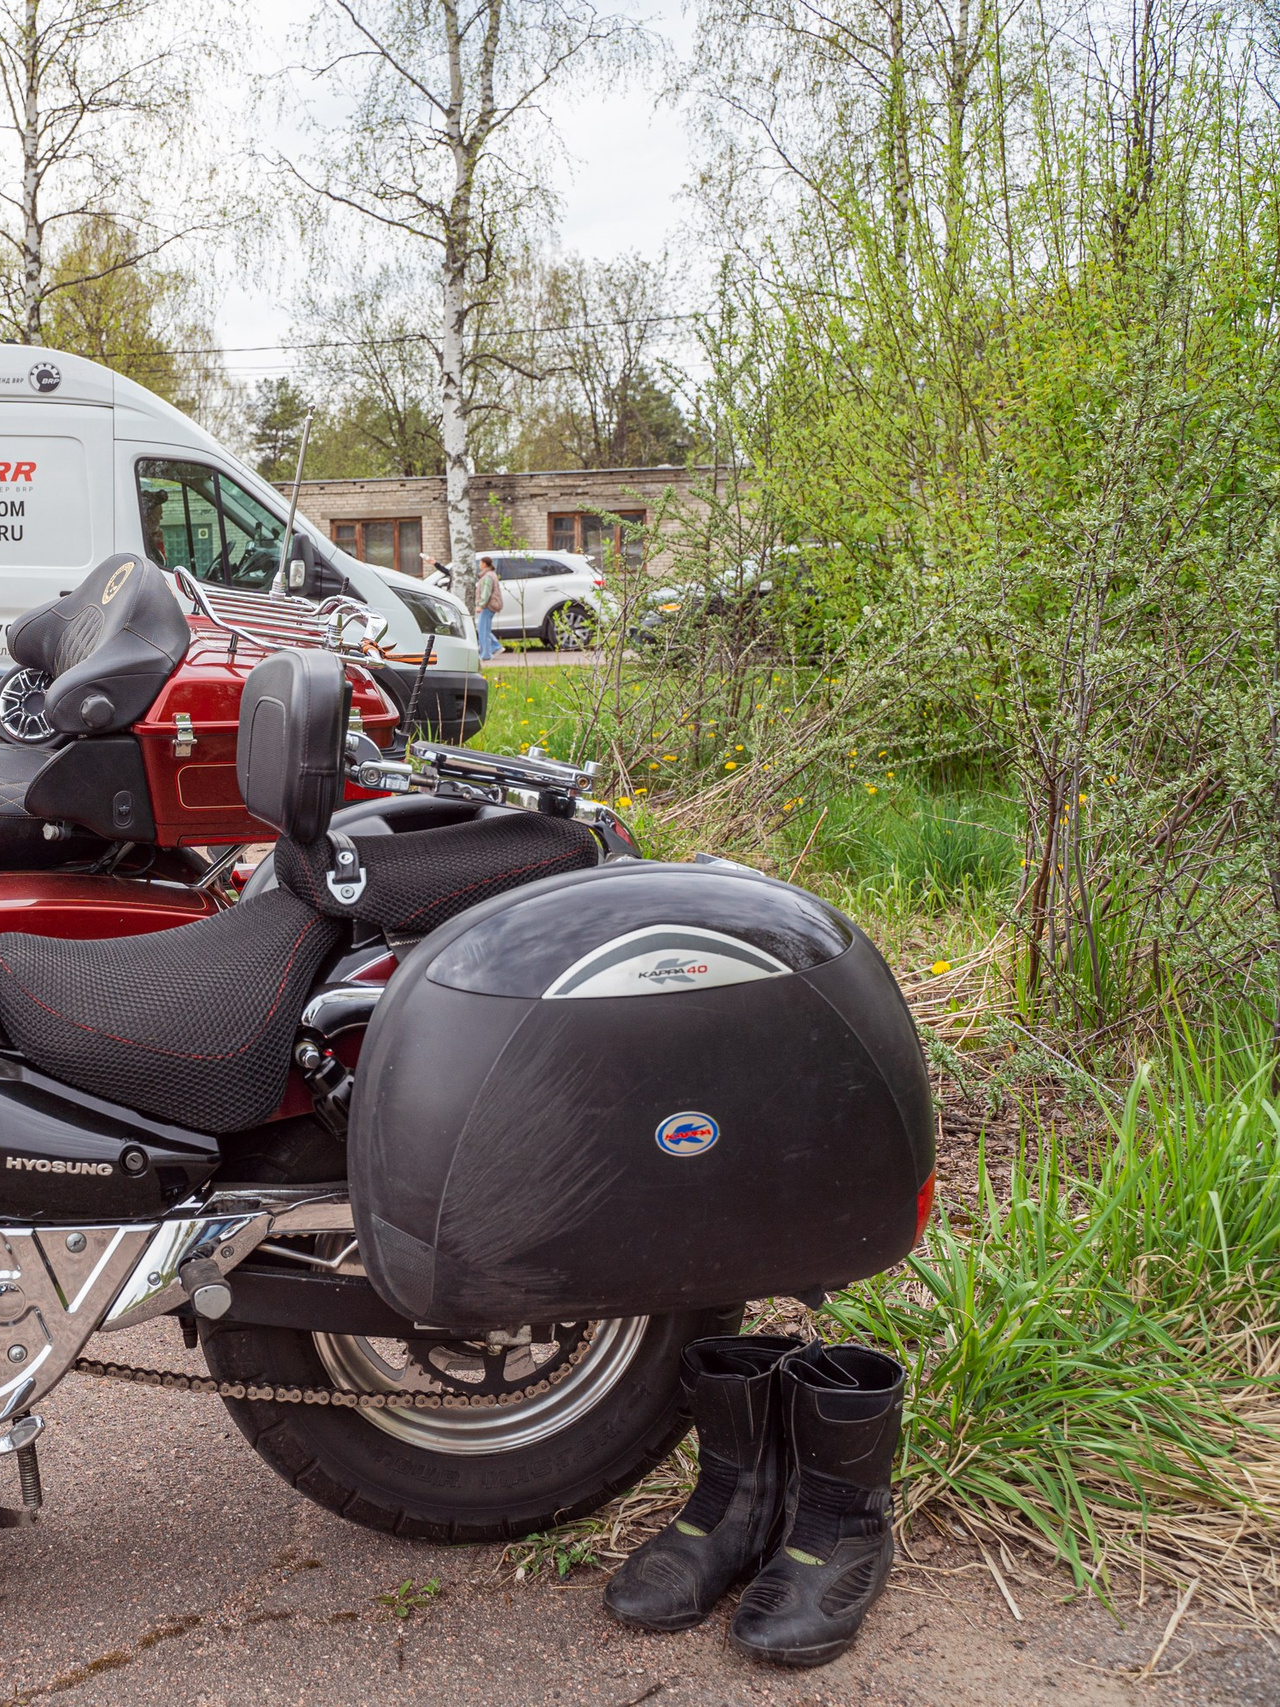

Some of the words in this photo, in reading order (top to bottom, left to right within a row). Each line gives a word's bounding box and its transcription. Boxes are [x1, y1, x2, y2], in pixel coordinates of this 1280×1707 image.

[42, 377, 60, 385] BRP
[638, 968, 685, 979] KAPPA
[687, 965, 708, 974] 40
[6, 1156, 113, 1175] HYOSUNG
